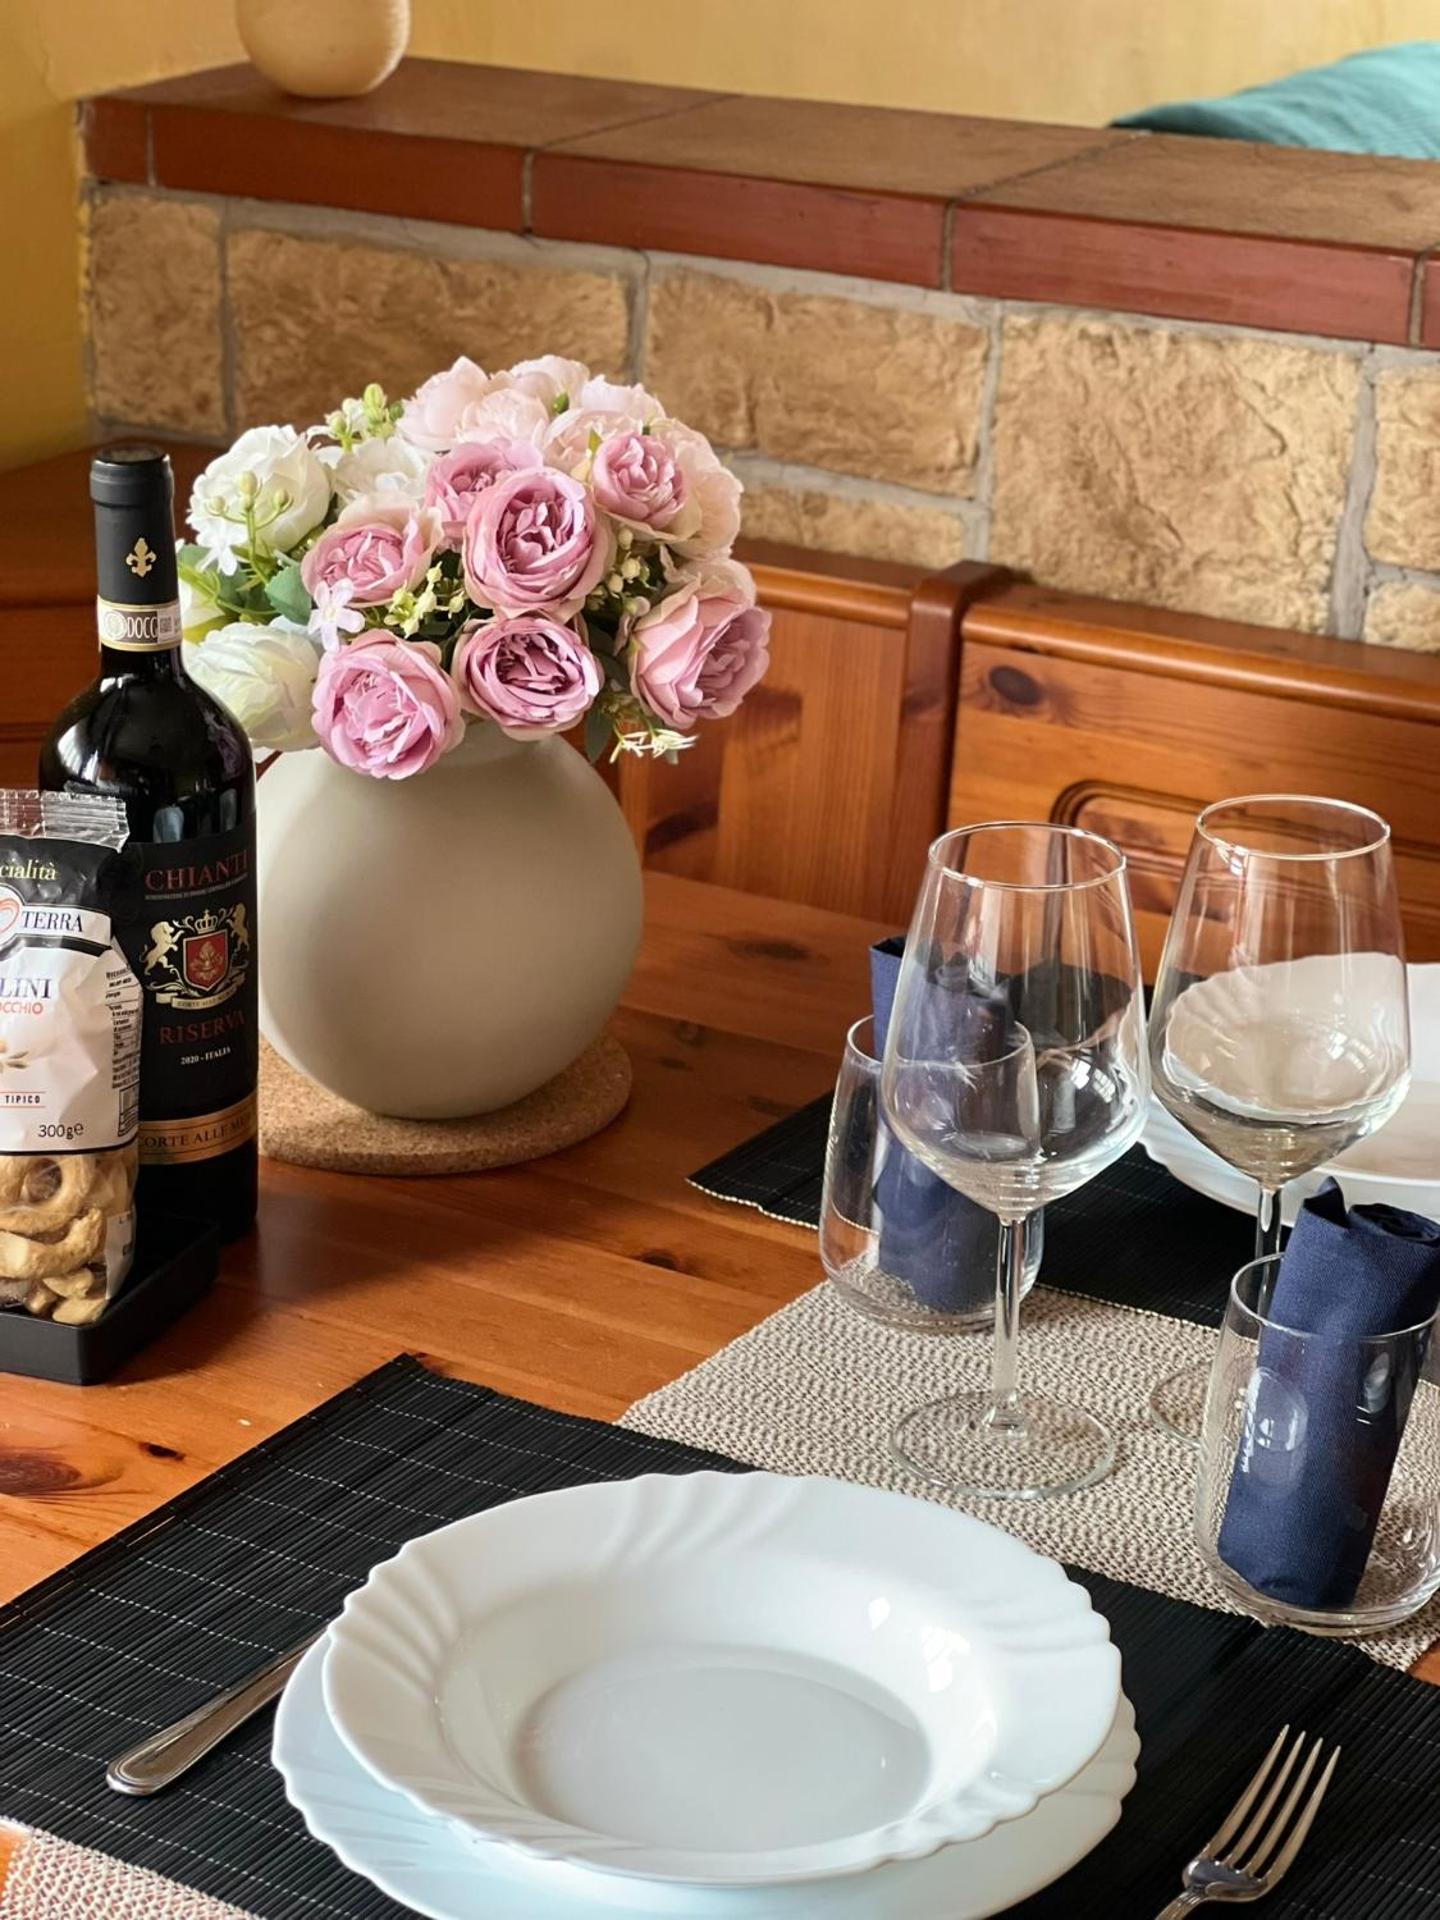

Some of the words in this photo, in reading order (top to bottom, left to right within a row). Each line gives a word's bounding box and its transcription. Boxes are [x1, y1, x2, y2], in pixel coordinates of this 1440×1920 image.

[145, 850, 249, 892] CHIANTI
[22, 910, 83, 932] TERRA
[0, 1001, 44, 1015] CCHIO
[160, 1011, 245, 1045] RISERVA
[181, 1056, 200, 1065] 2020
[205, 1046, 231, 1061] ITALIA
[5, 1095, 41, 1104] TIPICO
[194, 1125, 226, 1146] ALLE
